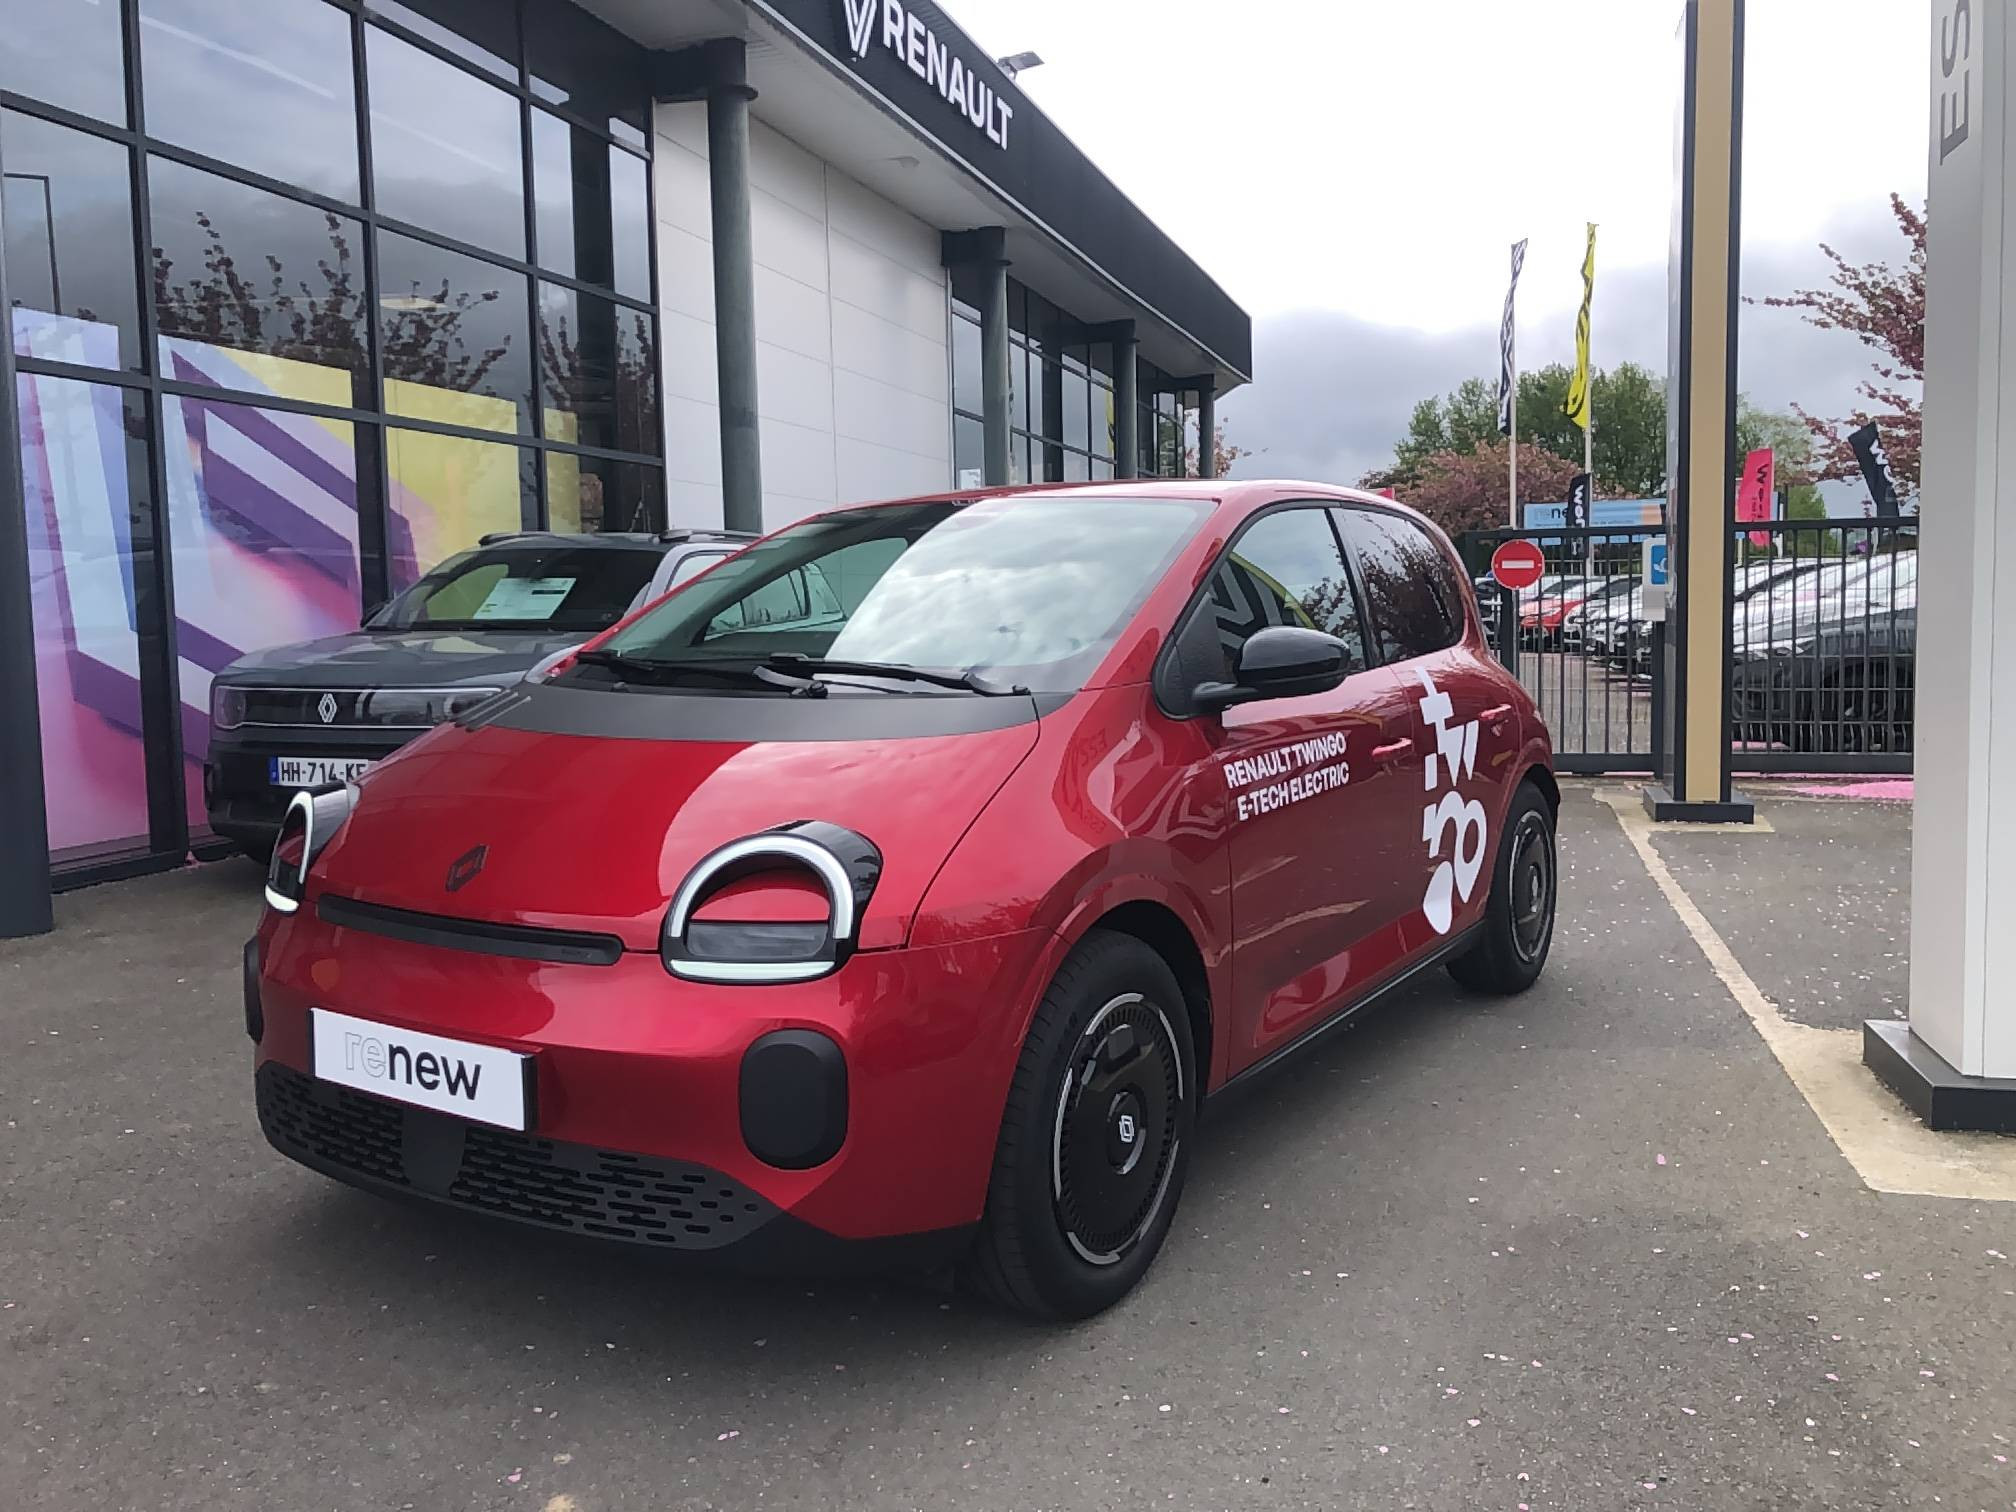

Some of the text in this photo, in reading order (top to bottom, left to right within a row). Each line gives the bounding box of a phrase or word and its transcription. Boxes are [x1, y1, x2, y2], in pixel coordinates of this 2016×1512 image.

[883, 0, 1013, 150] RENAULT
[1223, 731, 1347, 789] RENAULT TWINGO
[1237, 761, 1350, 821] E-TECH ELECTRIC
[345, 1032, 481, 1100] renew
